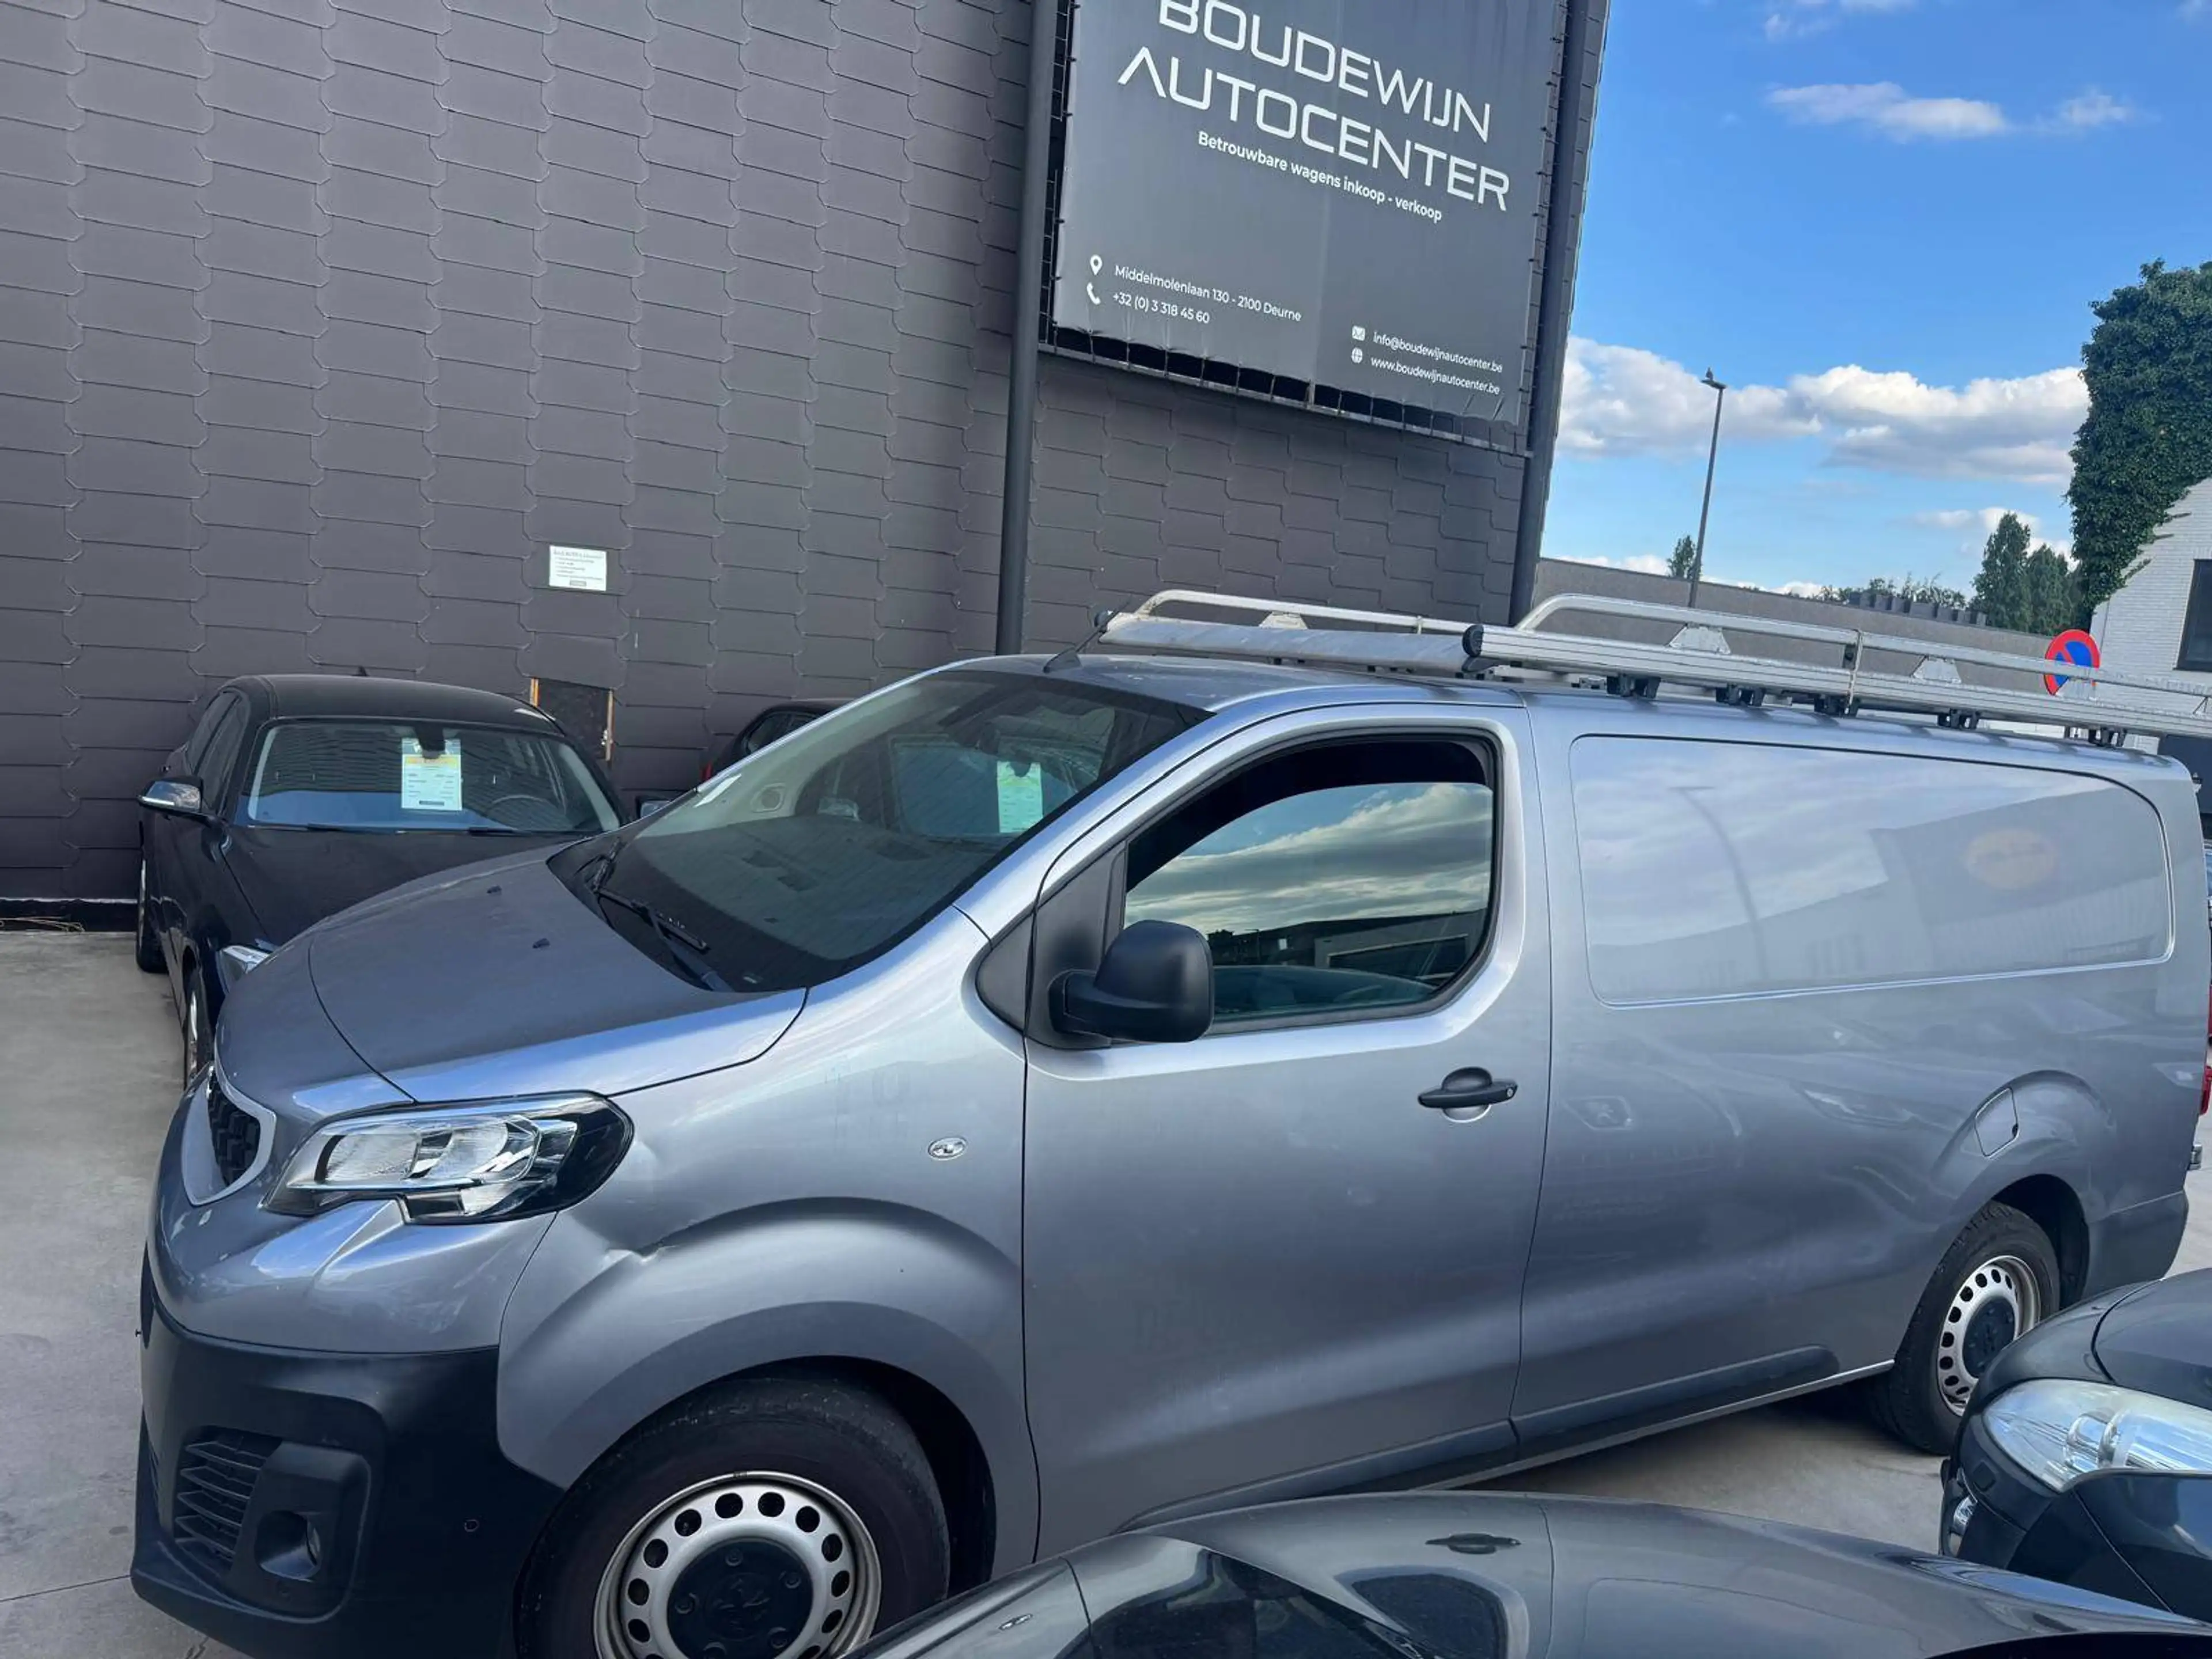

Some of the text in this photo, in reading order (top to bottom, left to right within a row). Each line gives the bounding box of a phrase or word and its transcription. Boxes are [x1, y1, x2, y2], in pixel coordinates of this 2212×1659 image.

[1159, 0, 1491, 143] BOUDEWIJN
[1117, 46, 1509, 211] AUTOCENTER
[1198, 130, 1288, 172] Betrouwbare
[1290, 162, 1341, 188] wagens
[1343, 175, 1385, 205] inkoop
[1395, 196, 1442, 224] verkoop
[1112, 291, 1210, 324] +32 (0) 3 318 45 60
[1115, 264, 1210, 299] Middelmolenlaan
[1212, 288, 1230, 304] 130
[1237, 295, 1262, 312] 2100
[1263, 301, 1302, 322] Deurne
[1371, 357, 1501, 395] www.boudewijnautocenter.be
[1373, 331, 1503, 373] info@boudewijnautocenter.be
